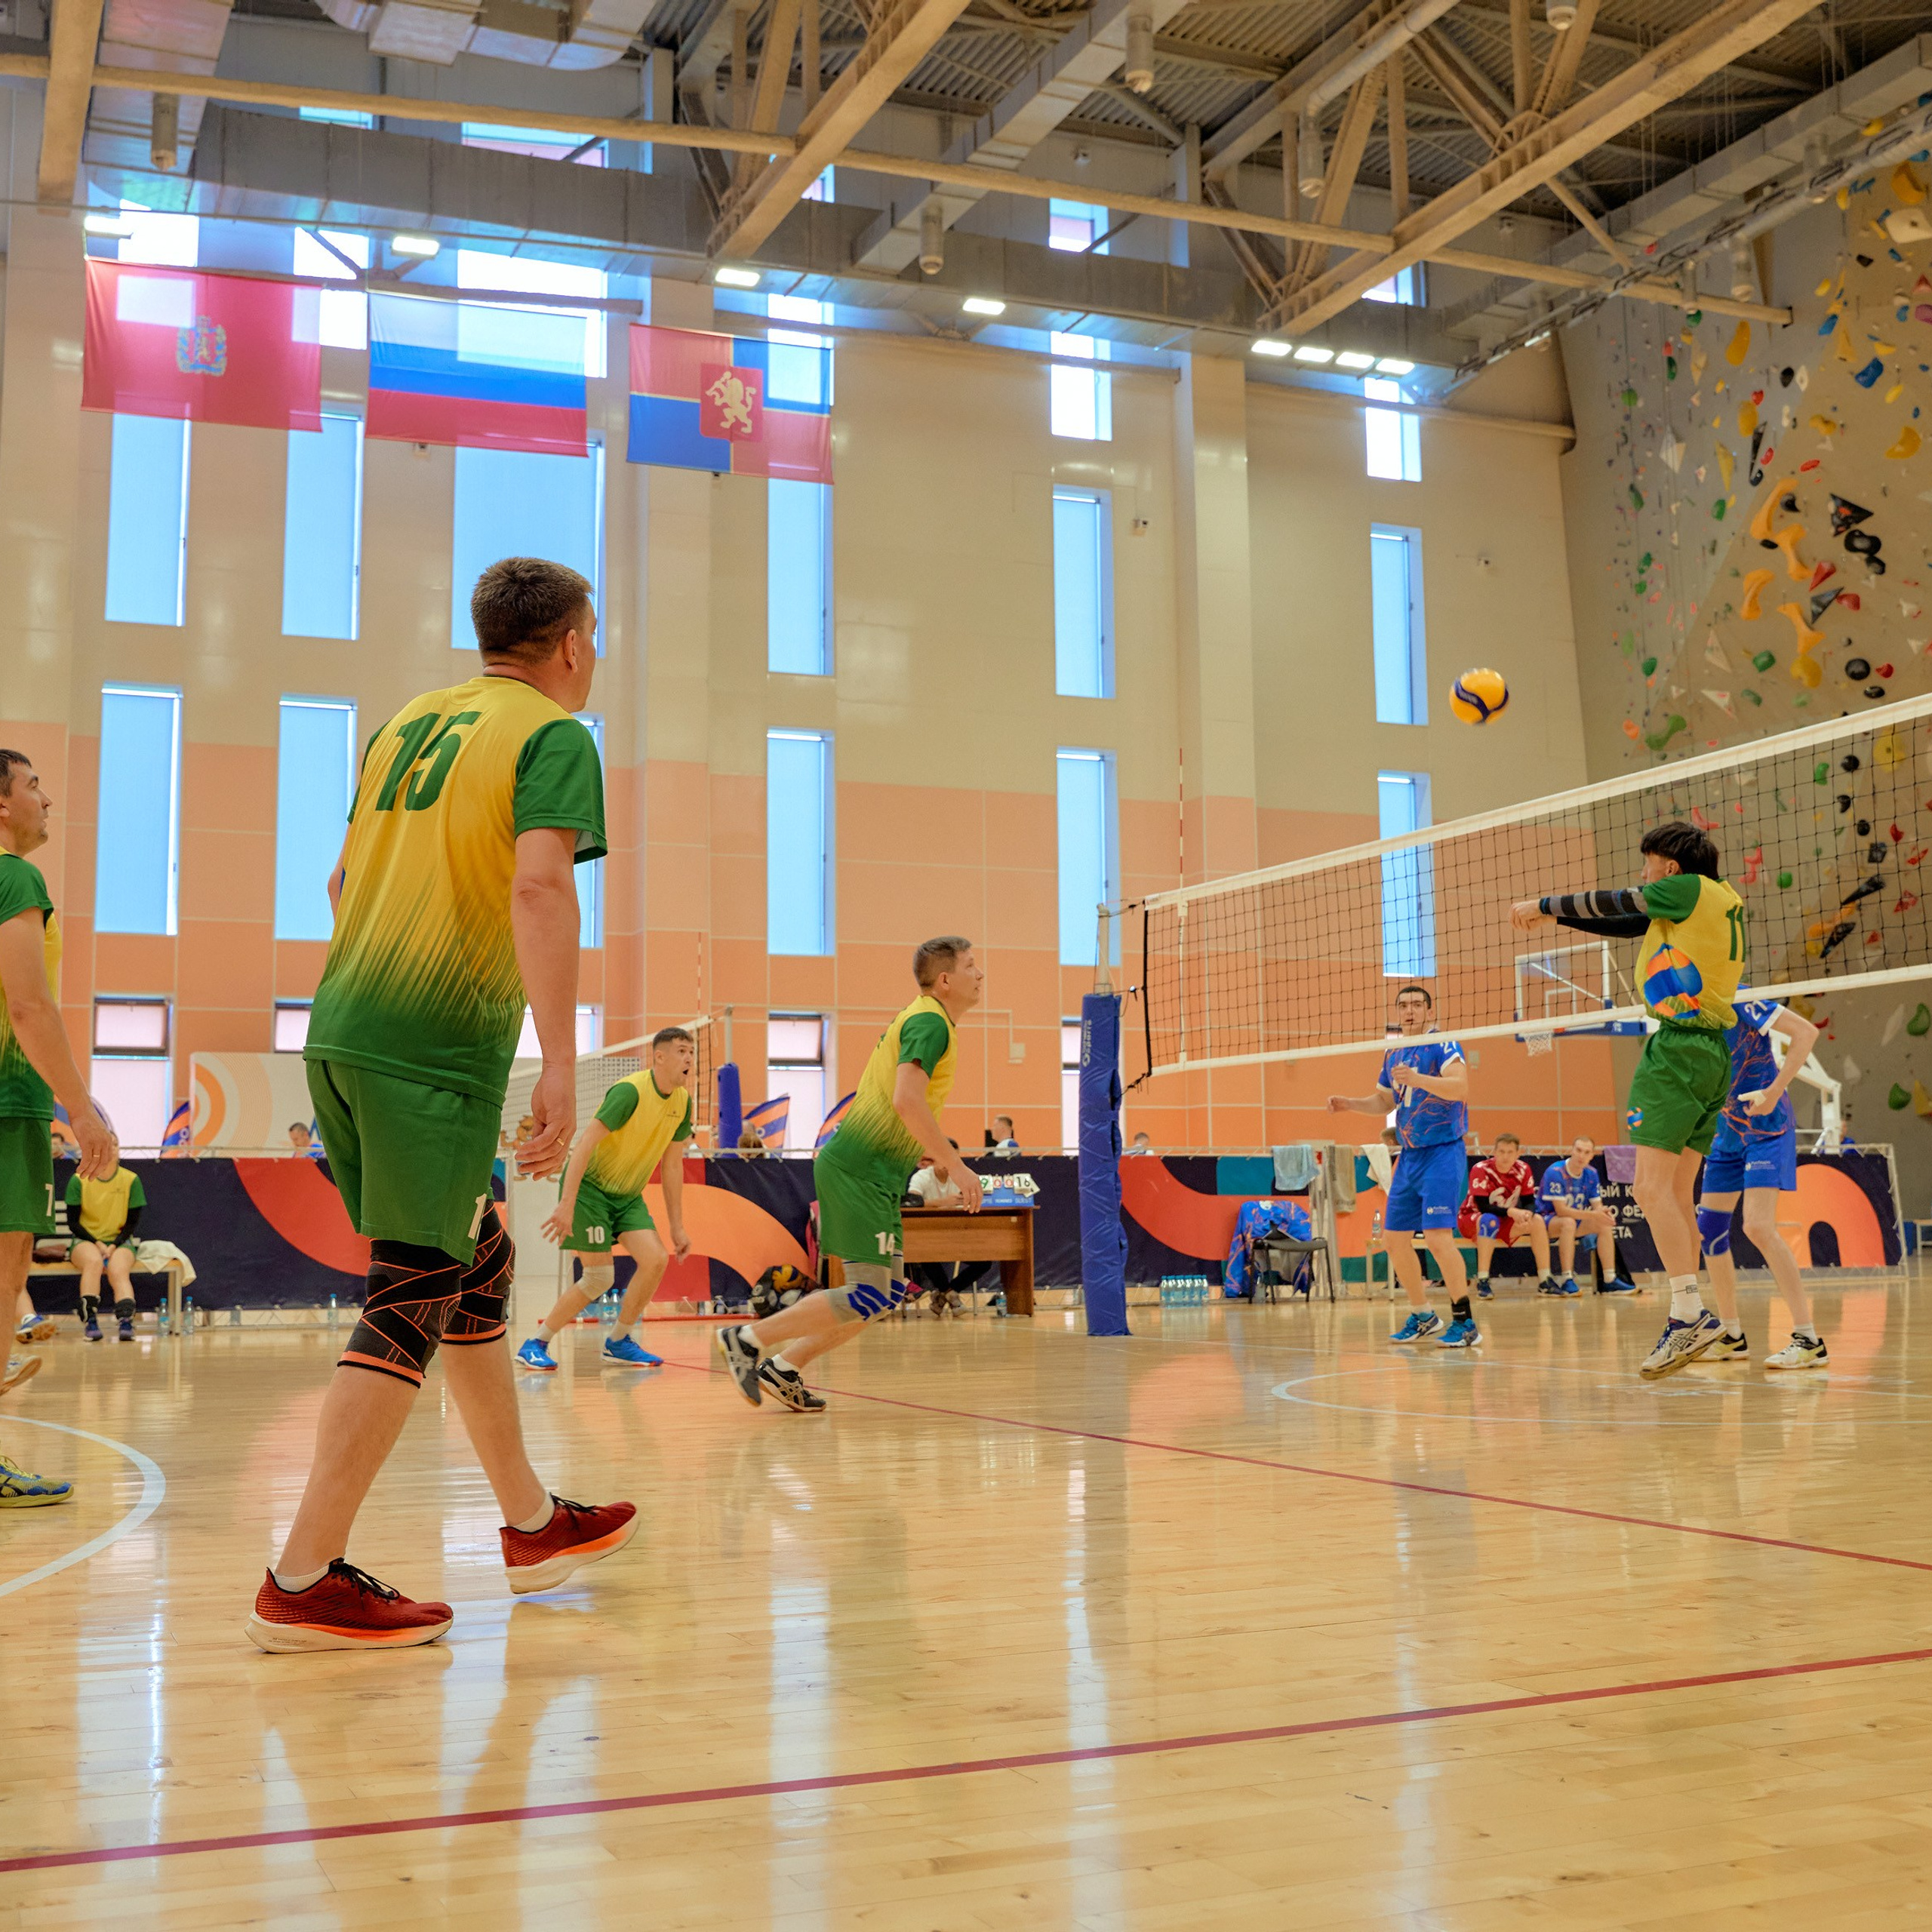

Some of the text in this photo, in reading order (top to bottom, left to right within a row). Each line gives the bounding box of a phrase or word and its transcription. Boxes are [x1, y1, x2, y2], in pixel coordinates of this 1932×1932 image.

[375, 711, 482, 811] 15
[1725, 905, 1746, 962] 11
[1017, 1177, 1030, 1187] 16
[1549, 1182, 1561, 1193] 23
[585, 1226, 605, 1244] 10
[875, 1231, 895, 1256] 14
